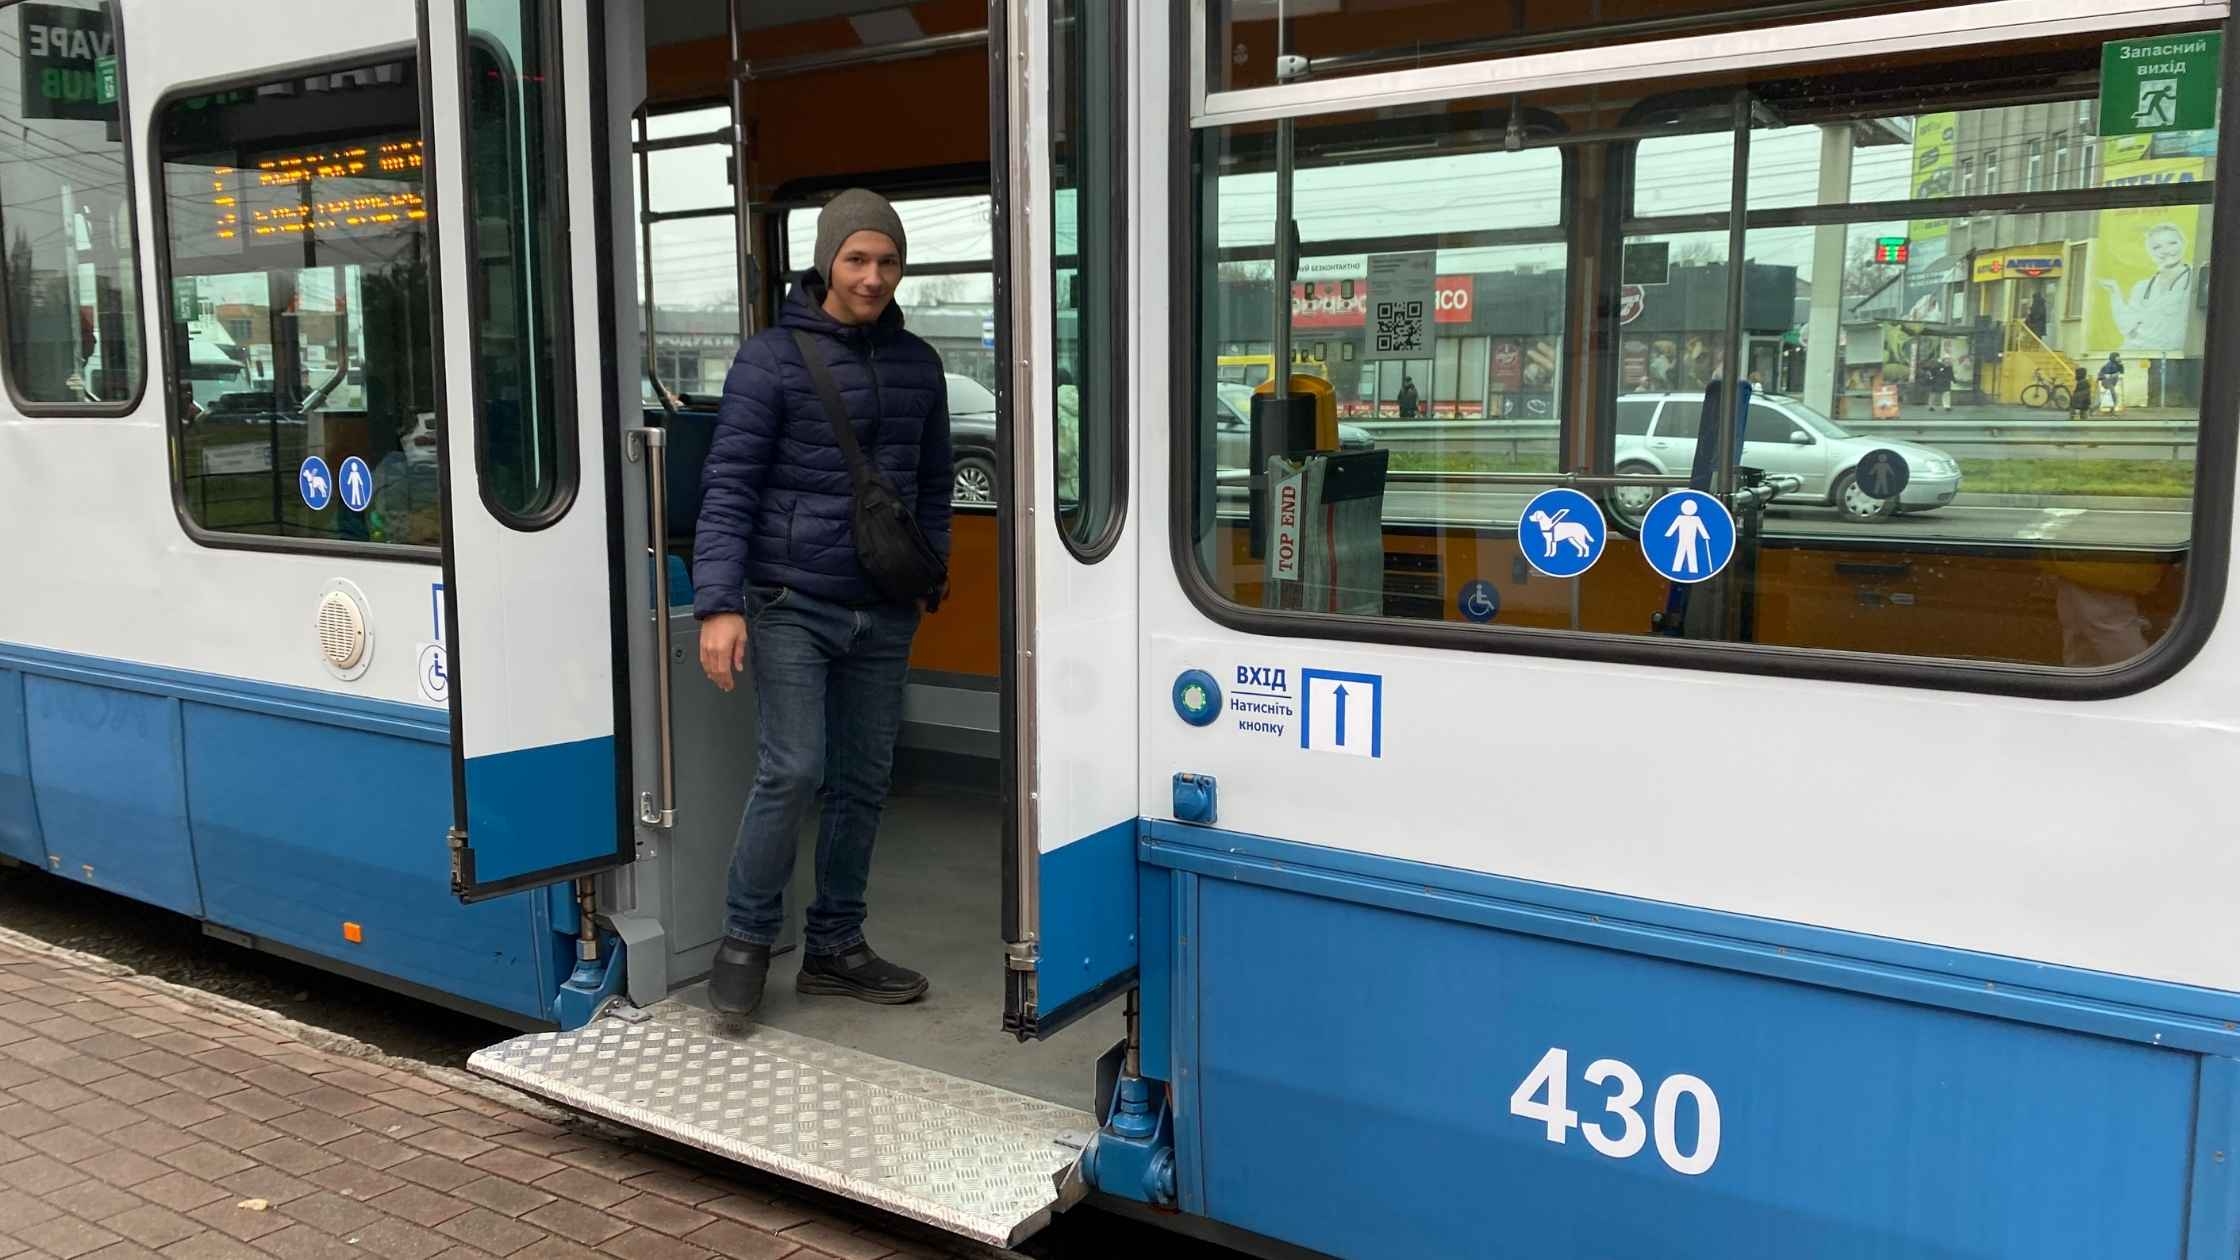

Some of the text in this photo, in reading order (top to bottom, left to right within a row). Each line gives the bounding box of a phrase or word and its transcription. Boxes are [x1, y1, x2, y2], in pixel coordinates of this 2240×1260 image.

[2119, 39, 2207, 60] Запасний
[2136, 59, 2187, 76] вихід
[1279, 485, 1297, 572] TOP END
[1237, 665, 1287, 692] ВХІД
[1231, 698, 1293, 716] Натисніть
[1239, 719, 1284, 737] кнопку
[1510, 1047, 1721, 1176] 430
